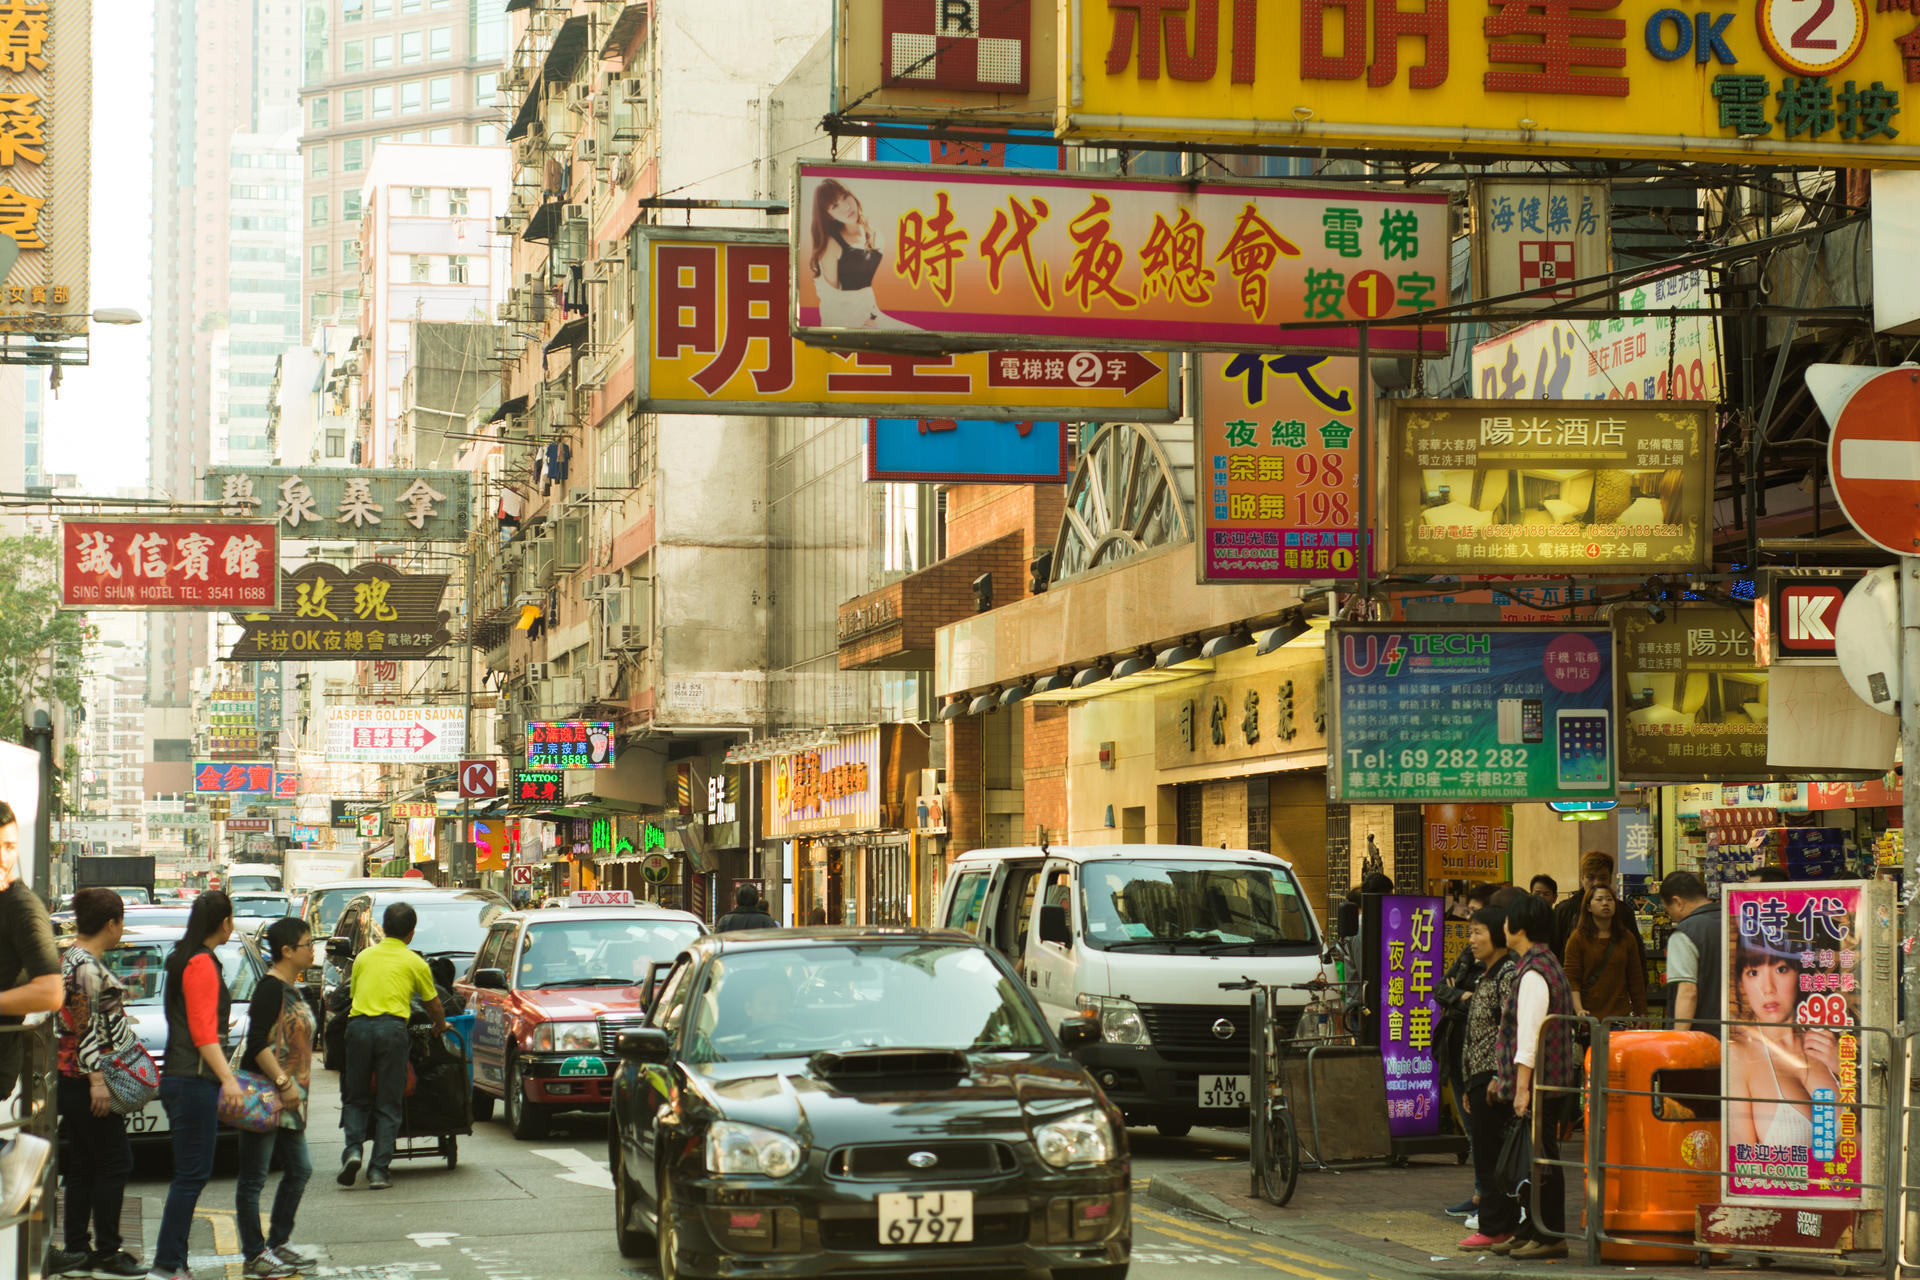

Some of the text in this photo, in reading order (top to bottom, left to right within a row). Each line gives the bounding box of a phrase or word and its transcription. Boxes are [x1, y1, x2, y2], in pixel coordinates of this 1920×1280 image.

[1645, 8, 1739, 64] OK
[1712, 73, 1901, 141] 電梯按
[1491, 196, 1600, 236] 海健藥房
[1322, 207, 1420, 262] 電梯
[896, 188, 1303, 323] 時代夜總會
[1000, 353, 1128, 387] 電梯按2字
[1224, 418, 1354, 449] 夜總會
[1479, 416, 1628, 447] 陽光酒店
[1417, 438, 1477, 451] 豪華大套房
[1230, 453, 1343, 488] 茶舞 98
[1230, 491, 1350, 526] 晚舞 198
[1214, 532, 1279, 546] 歡迎光臨
[75, 530, 264, 581] 誠信賓館
[1213, 549, 1279, 559] WELCOME
[1284, 548, 1361, 571] 電梯按1
[1456, 543, 1534, 559] 請由此進入
[73, 585, 266, 600] SING SHUN HOTEL TEL: 3541 1688
[245, 575, 399, 622] 玫瑰
[250, 629, 386, 652] 卡拉OK夜總會
[1409, 634, 1491, 654] TECH
[1686, 628, 1756, 657] 陽光
[329, 708, 464, 721] JASPER GOLDEN SAUNA
[1746, 723, 1768, 735] 522
[533, 754, 588, 765] 2711 3588
[1347, 749, 1528, 769] Tel: 69 282 282
[196, 765, 272, 791] 金多寶
[468, 766, 492, 792] K
[519, 773, 559, 783] TATTOO
[1432, 789, 1457, 797] WAH
[1457, 789, 1479, 797] MAY
[1481, 789, 1528, 797] BUILDING
[1430, 823, 1511, 852] 陽光酒店
[1442, 852, 1499, 869] Sun Hotel
[577, 892, 630, 905] TAXI
[1740, 896, 1850, 942] 時代
[1800, 949, 1856, 969] 夜總會
[1387, 939, 1406, 1042] 夜總會
[1409, 907, 1434, 1052] 好年華
[1797, 993, 1847, 1030] $98
[578, 1059, 589, 1069] 4
[1386, 1056, 1433, 1078] Night Club
[1213, 1076, 1237, 1092] AM
[1736, 1144, 1808, 1163] 歡迎光臨
[1735, 1163, 1809, 1179] WELCOME
[907, 1194, 946, 1218] TJ
[887, 1217, 963, 1243] 6797
